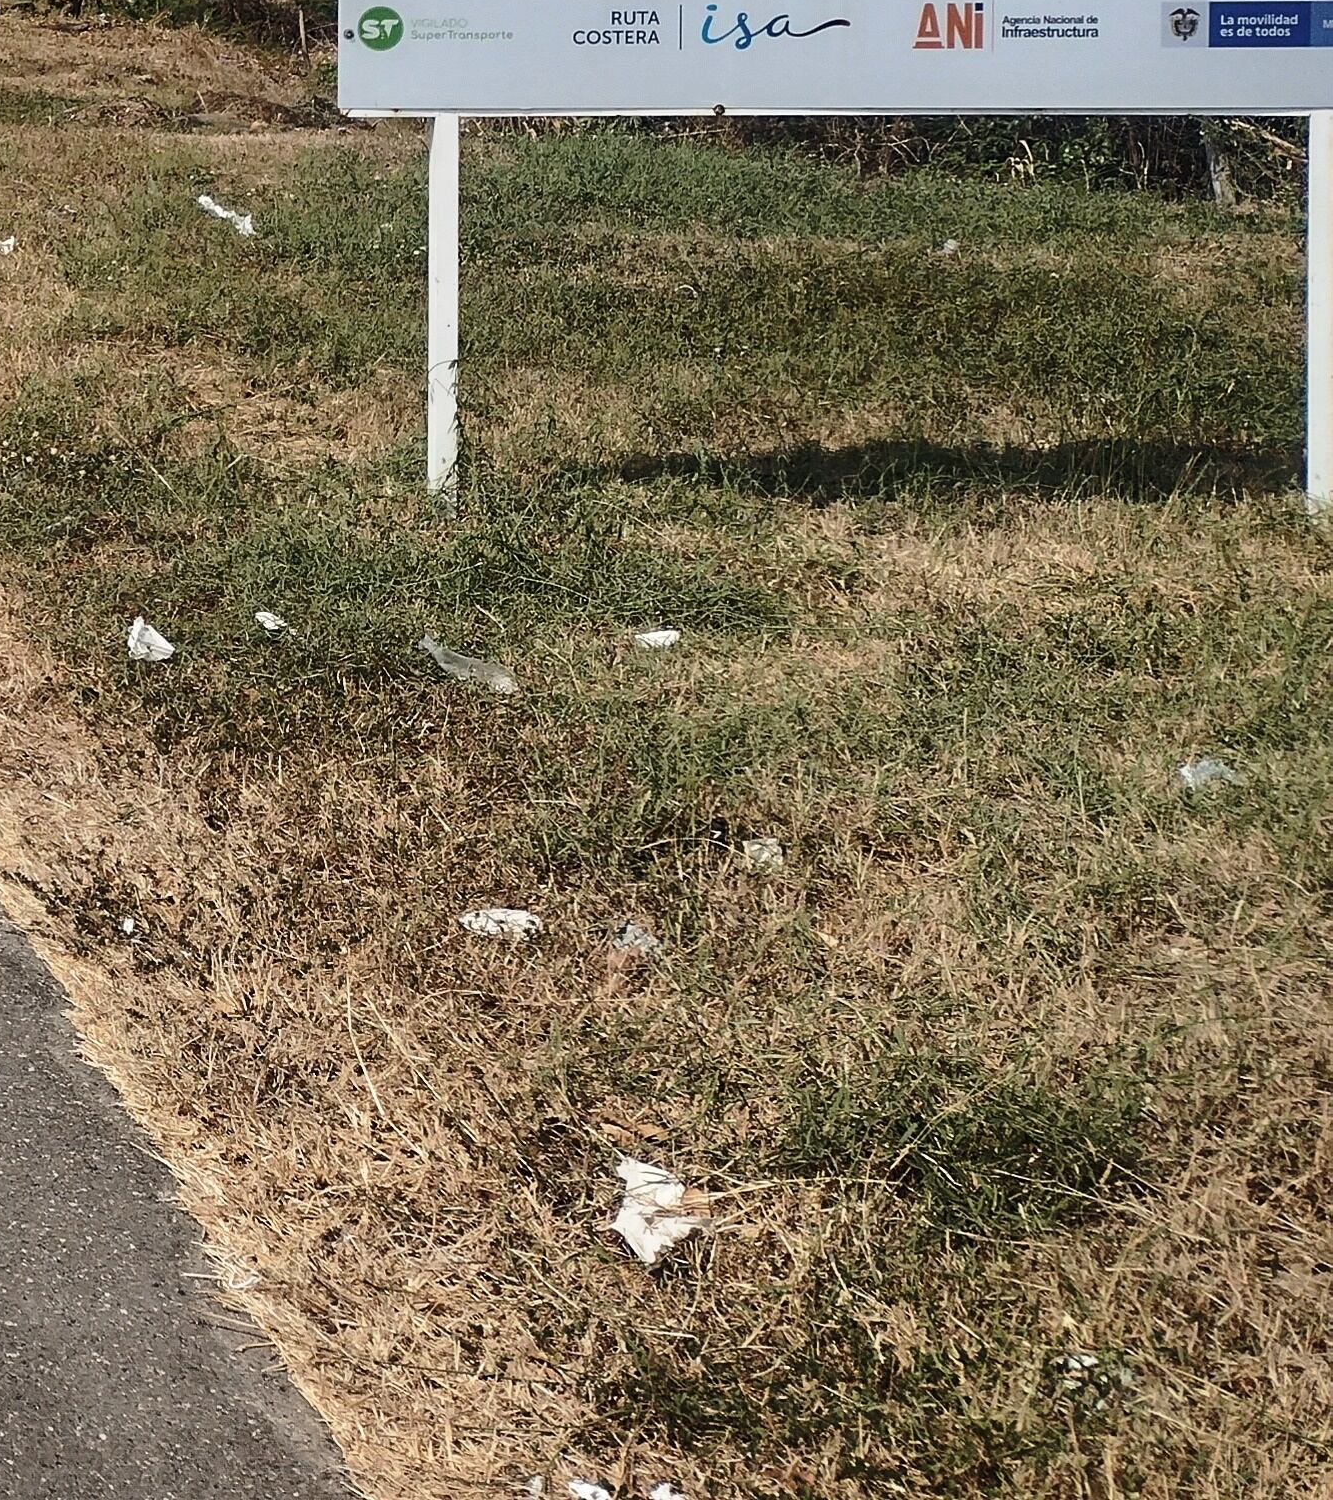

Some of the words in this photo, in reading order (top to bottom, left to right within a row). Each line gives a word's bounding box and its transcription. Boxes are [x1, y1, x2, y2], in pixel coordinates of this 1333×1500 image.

[411, 18, 468, 29] VIGILADO
[611, 11, 660, 25] RUTA
[1002, 16, 1041, 26] Agencia
[1043, 15, 1084, 25] Nacional
[1086, 15, 1099, 25] de
[1220, 14, 1235, 25] La
[1237, 14, 1299, 26] movilidad
[701, 4, 851, 50] isa
[1002, 26, 1099, 38] Infraestructura
[1220, 27, 1234, 37] es
[1236, 26, 1253, 37] de
[1255, 26, 1291, 37] todos
[411, 30, 513, 41] SuperTransporte
[573, 30, 660, 45] COSTERA
